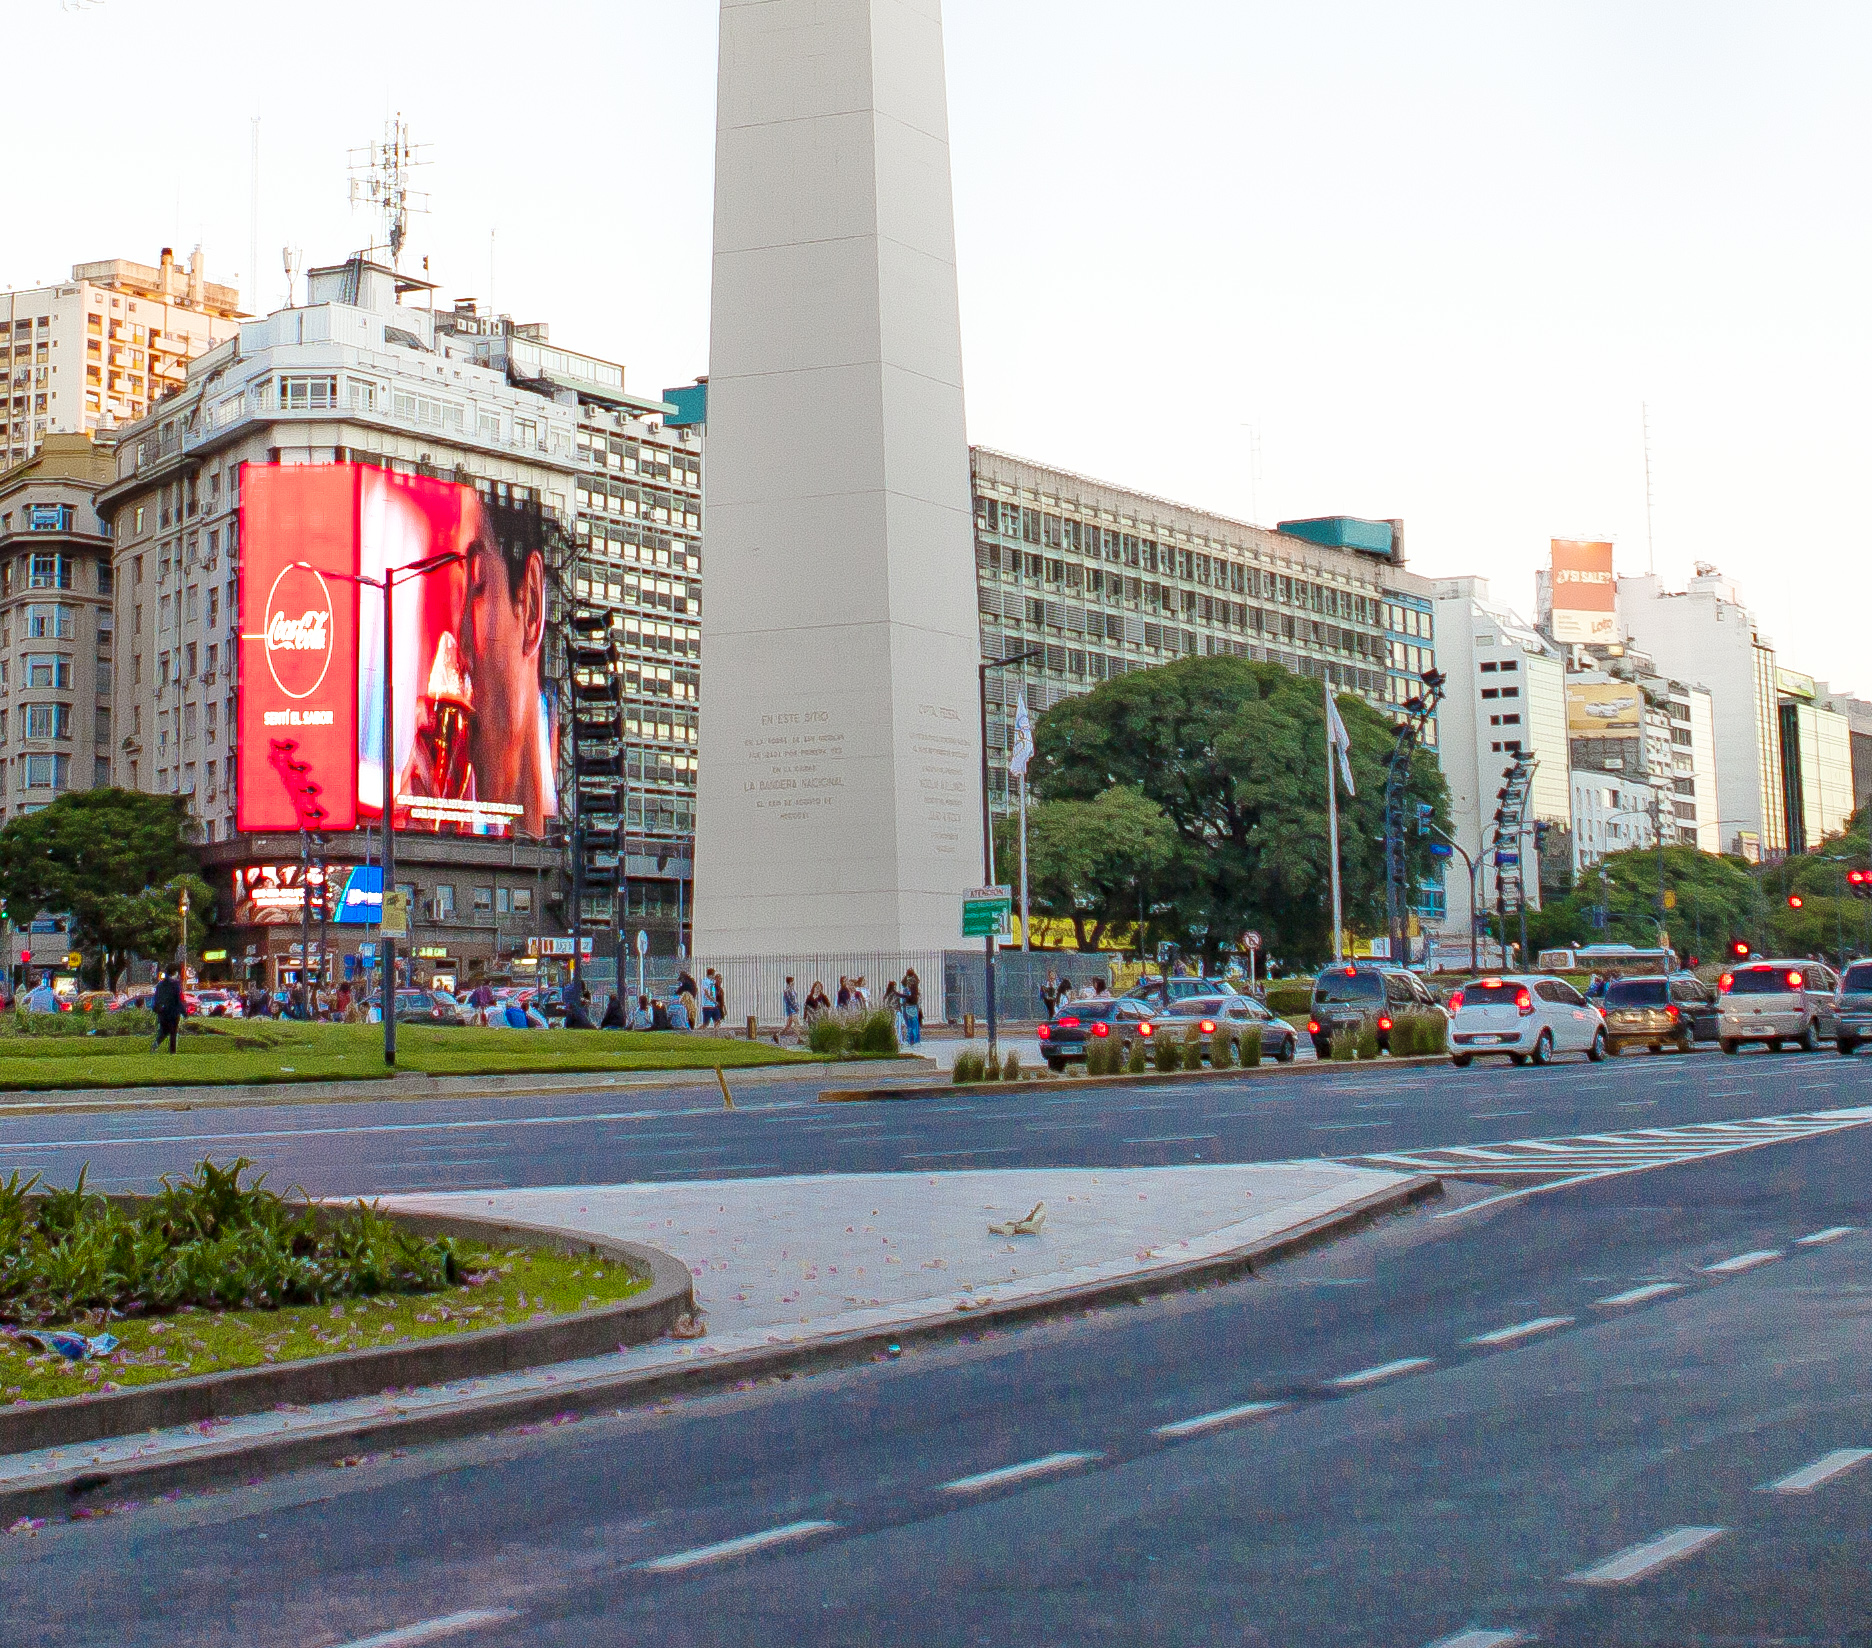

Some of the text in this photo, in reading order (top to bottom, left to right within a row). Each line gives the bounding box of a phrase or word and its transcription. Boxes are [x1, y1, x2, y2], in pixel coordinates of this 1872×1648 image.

[777, 713, 799, 725] ESTE
[744, 777, 845, 792] LA BANDERA NACIONAL
